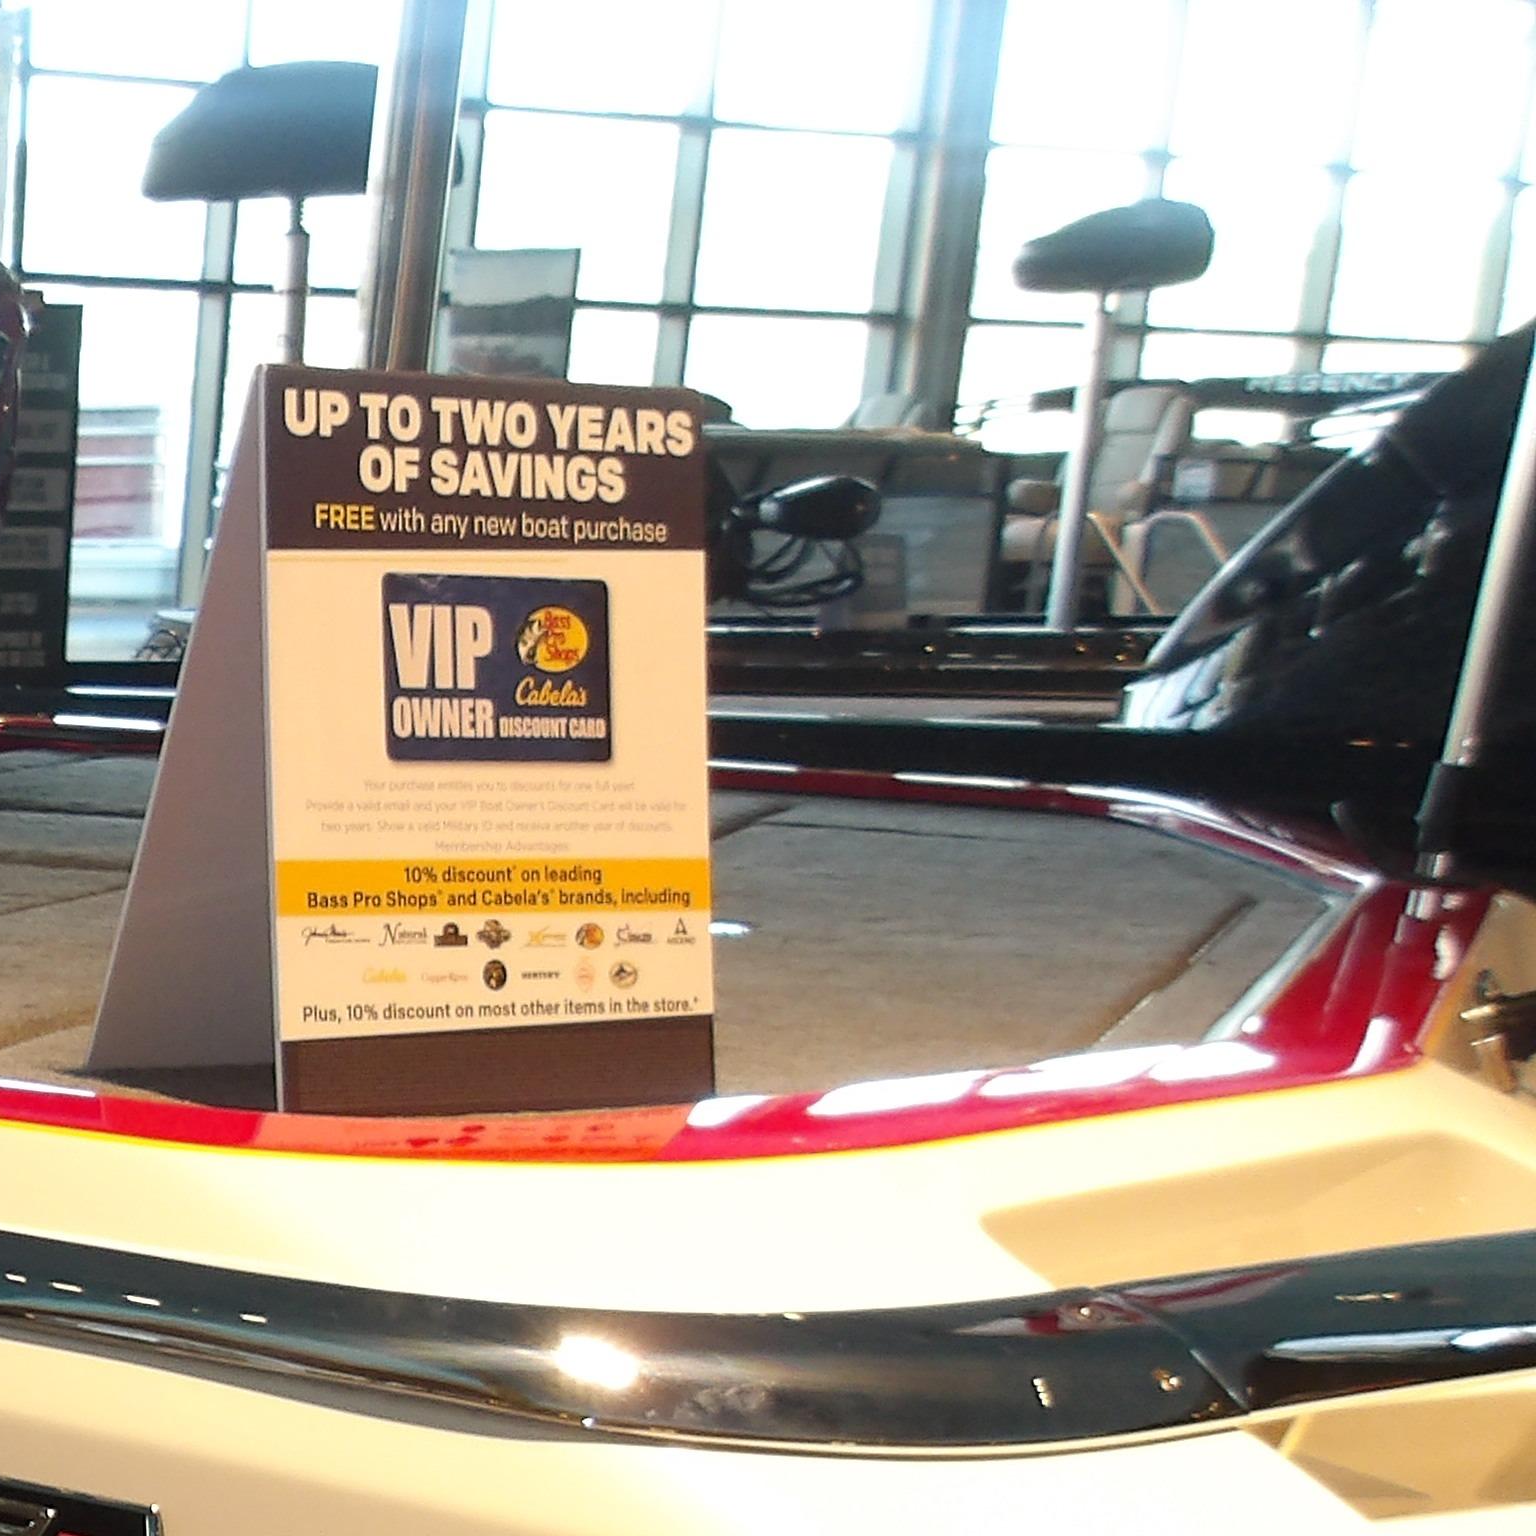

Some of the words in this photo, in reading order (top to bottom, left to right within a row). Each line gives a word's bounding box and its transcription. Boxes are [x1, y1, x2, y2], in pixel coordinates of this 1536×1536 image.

[284, 388, 349, 437] UP
[359, 391, 421, 443] TO
[430, 398, 537, 450] TWO
[545, 404, 696, 457] YEARS
[359, 445, 419, 494] OF
[430, 452, 627, 503] SAVINGS
[315, 503, 375, 531] FREE
[379, 506, 426, 535] with
[430, 514, 469, 540] any
[474, 514, 518, 537] new
[522, 511, 568, 539] boat
[572, 514, 667, 543] purchase
[544, 611, 571, 629] Bass
[388, 602, 493, 690] VIP
[546, 644, 579, 664] Shops
[393, 696, 495, 739] OWNER
[499, 716, 567, 739] DISCOUNT
[569, 717, 606, 738] CARD
[404, 866, 438, 883] 10%
[521, 869, 540, 882] on
[544, 865, 602, 885] leading
[307, 892, 348, 908] Bass
[353, 891, 381, 908] Pro
[447, 890, 477, 906] and
[559, 889, 617, 907] brands,
[621, 888, 690, 908] including
[303, 1005, 342, 1024] Plus,
[347, 1004, 378, 1021] 10%
[383, 1002, 451, 1020] discount
[455, 1006, 474, 1017] on
[479, 1002, 516, 1017] most
[520, 1000, 560, 1016] other
[564, 999, 605, 1015] items
[609, 998, 622, 1013] in
[627, 996, 649, 1012] the
